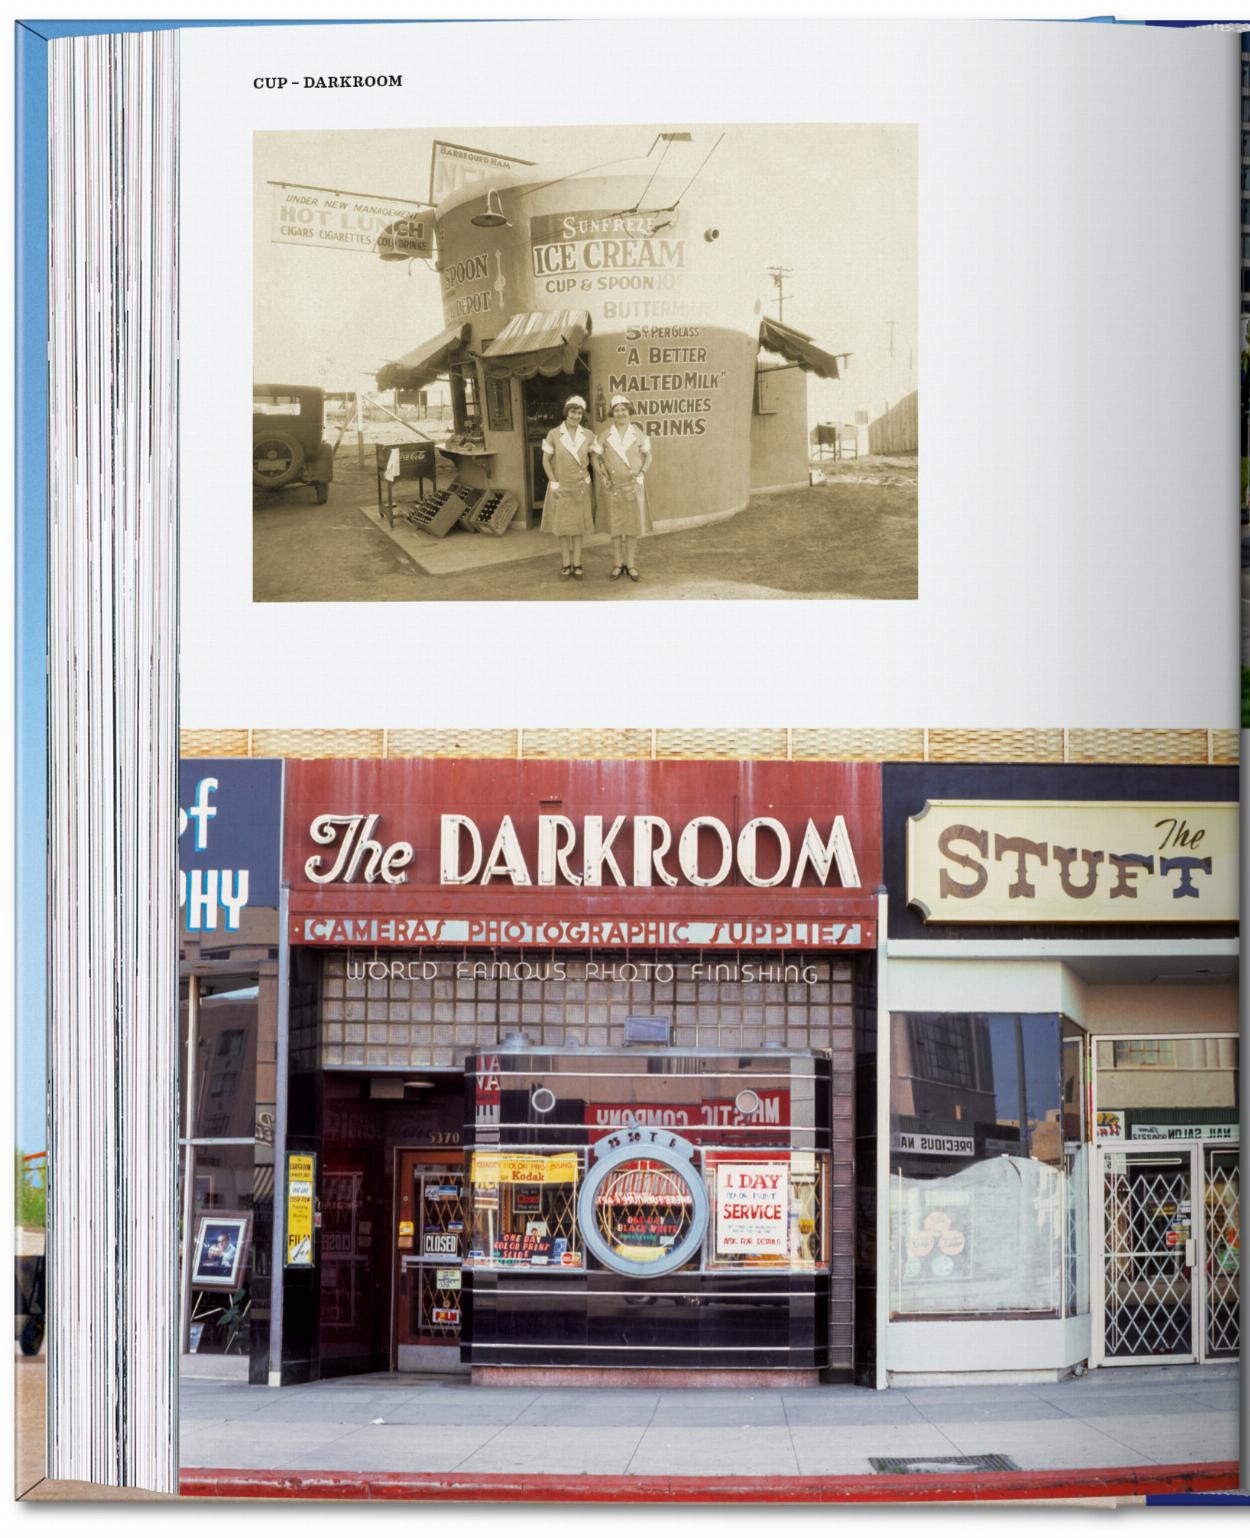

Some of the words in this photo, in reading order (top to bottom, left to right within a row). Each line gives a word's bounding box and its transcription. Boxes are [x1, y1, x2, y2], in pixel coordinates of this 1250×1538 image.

[253, 77, 288, 89] CUP
[303, 75, 403, 89] DARKROOM
[286, 194, 319, 206] UNDER
[324, 199, 349, 209] NEW
[353, 203, 418, 220] MANAGEMENT
[280, 205, 332, 226] HOT
[340, 212, 425, 239] LUNCH
[280, 226, 314, 238] CIGARS
[319, 230, 372, 245] CIGARETTES
[534, 243, 577, 274] ICE
[583, 239, 685, 270] CREAM
[545, 278, 577, 293] CUP
[580, 279, 593, 291] &
[597, 276, 655, 290] SPOON
[651, 327, 671, 338] PER
[671, 326, 699, 338] GLASS
[649, 347, 707, 363] BETTER
[609, 374, 683, 393] MALTED
[630, 398, 712, 415] ANDWICHES
[1154, 818, 1206, 850] The
[304, 814, 414, 885] The
[440, 814, 862, 888] DARKROOM
[937, 823, 1213, 900] STUFT
[308, 919, 447, 943] CAMERAS
[467, 920, 691, 944] PHOTOGRAPHIC
[708, 922, 855, 945] SUPPLIES
[346, 961, 438, 981] WORLD
[456, 961, 567, 982] FAMOUS
[584, 962, 675, 983] PHOTO
[690, 963, 819, 985] FINISHING
[511, 1170, 545, 1182] Kodak
[738, 1173, 783, 1189] DAY
[723, 1204, 782, 1220] SERVICE
[426, 1235, 457, 1253] CLOSED
[523, 1241, 550, 1251] PRINT
